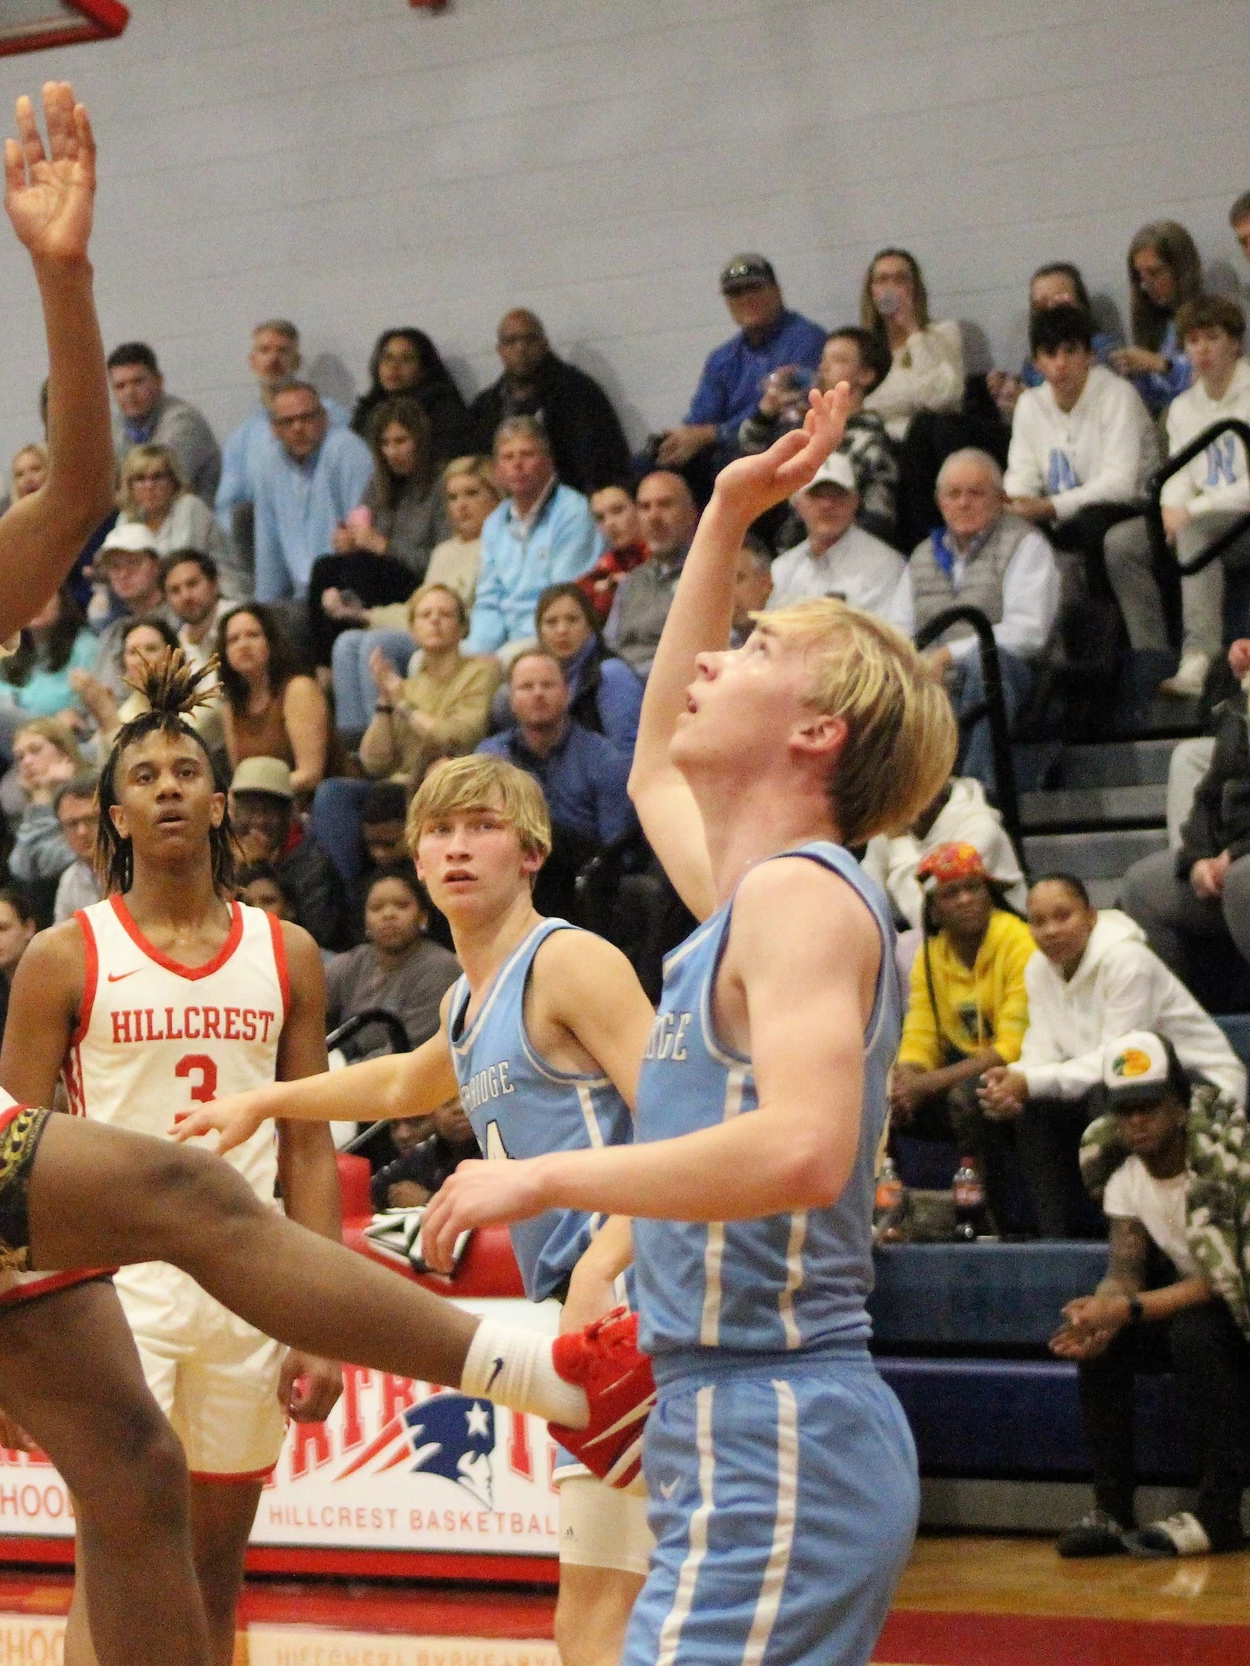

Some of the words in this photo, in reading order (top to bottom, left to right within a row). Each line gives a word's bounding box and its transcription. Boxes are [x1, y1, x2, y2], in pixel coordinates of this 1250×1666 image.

[110, 1006, 276, 1044] HILLCREST
[174, 1053, 218, 1137] 3
[269, 1504, 398, 1530] HILLCREST
